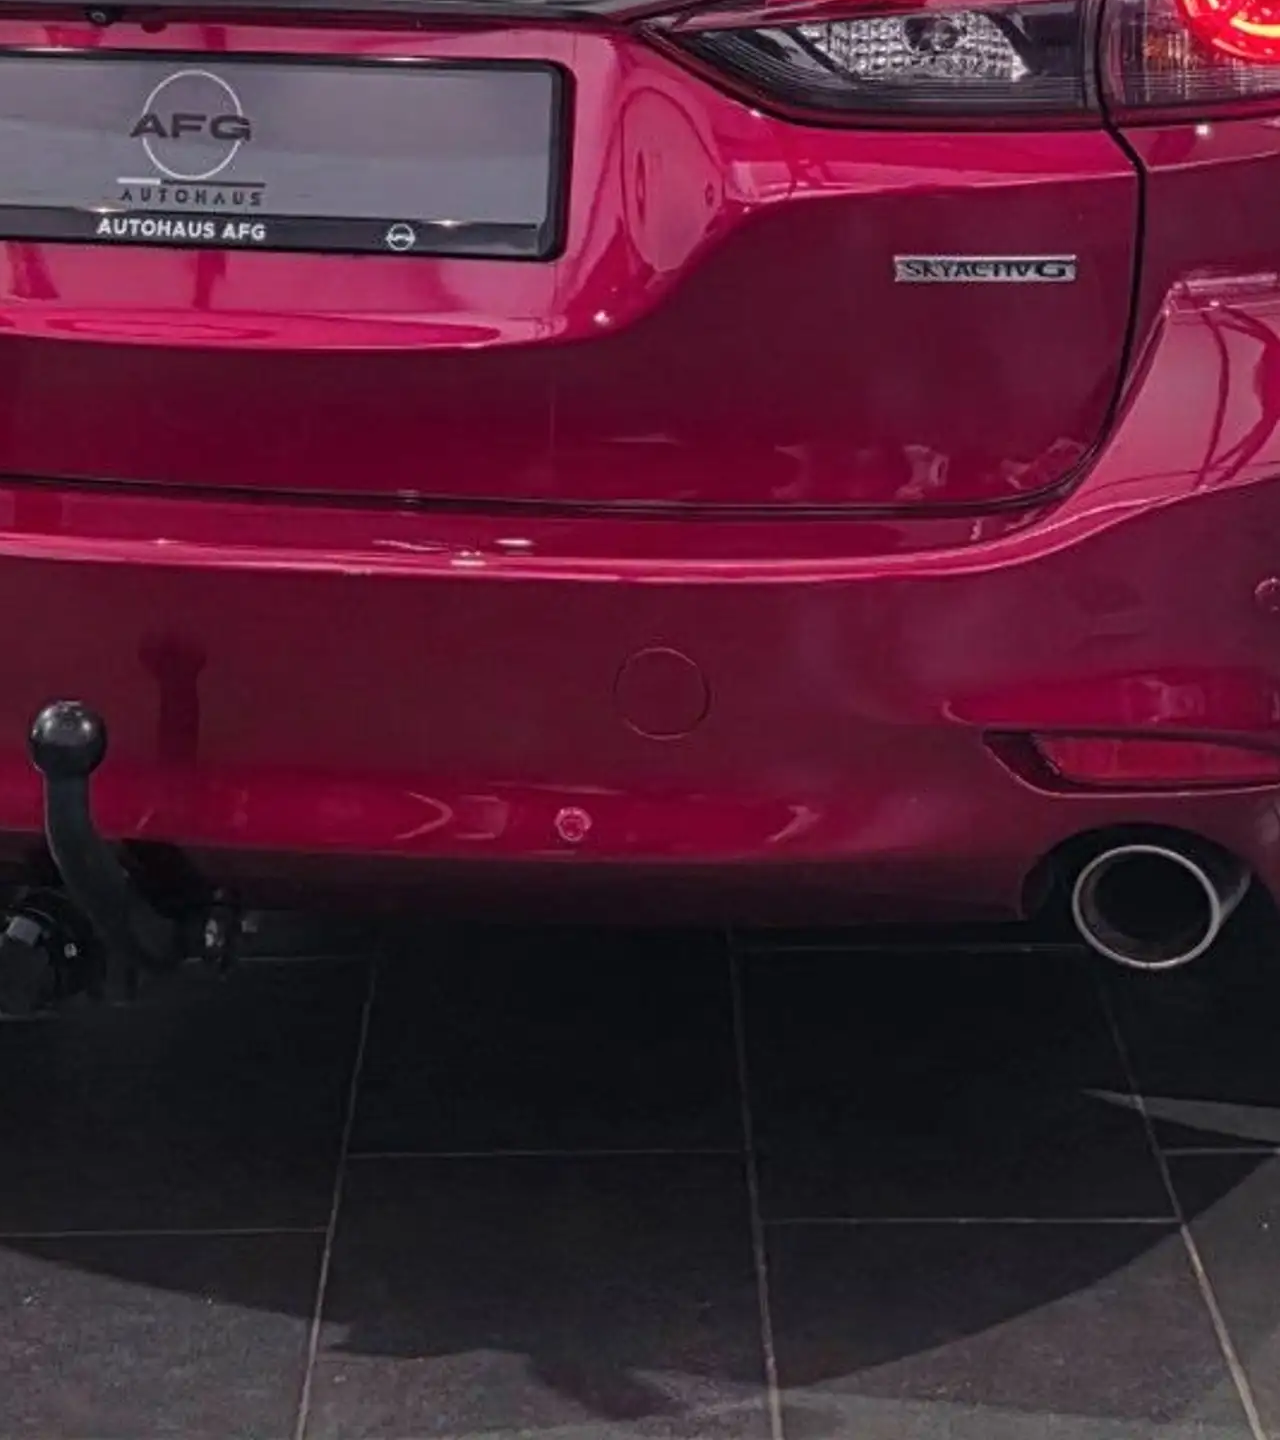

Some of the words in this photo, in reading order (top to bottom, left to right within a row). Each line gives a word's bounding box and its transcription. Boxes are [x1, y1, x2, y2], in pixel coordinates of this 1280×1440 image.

[130, 112, 252, 141] AFG
[121, 188, 261, 205] AUTOHAUS
[97, 218, 215, 239] AUTOHAUS
[222, 223, 267, 241] AFG
